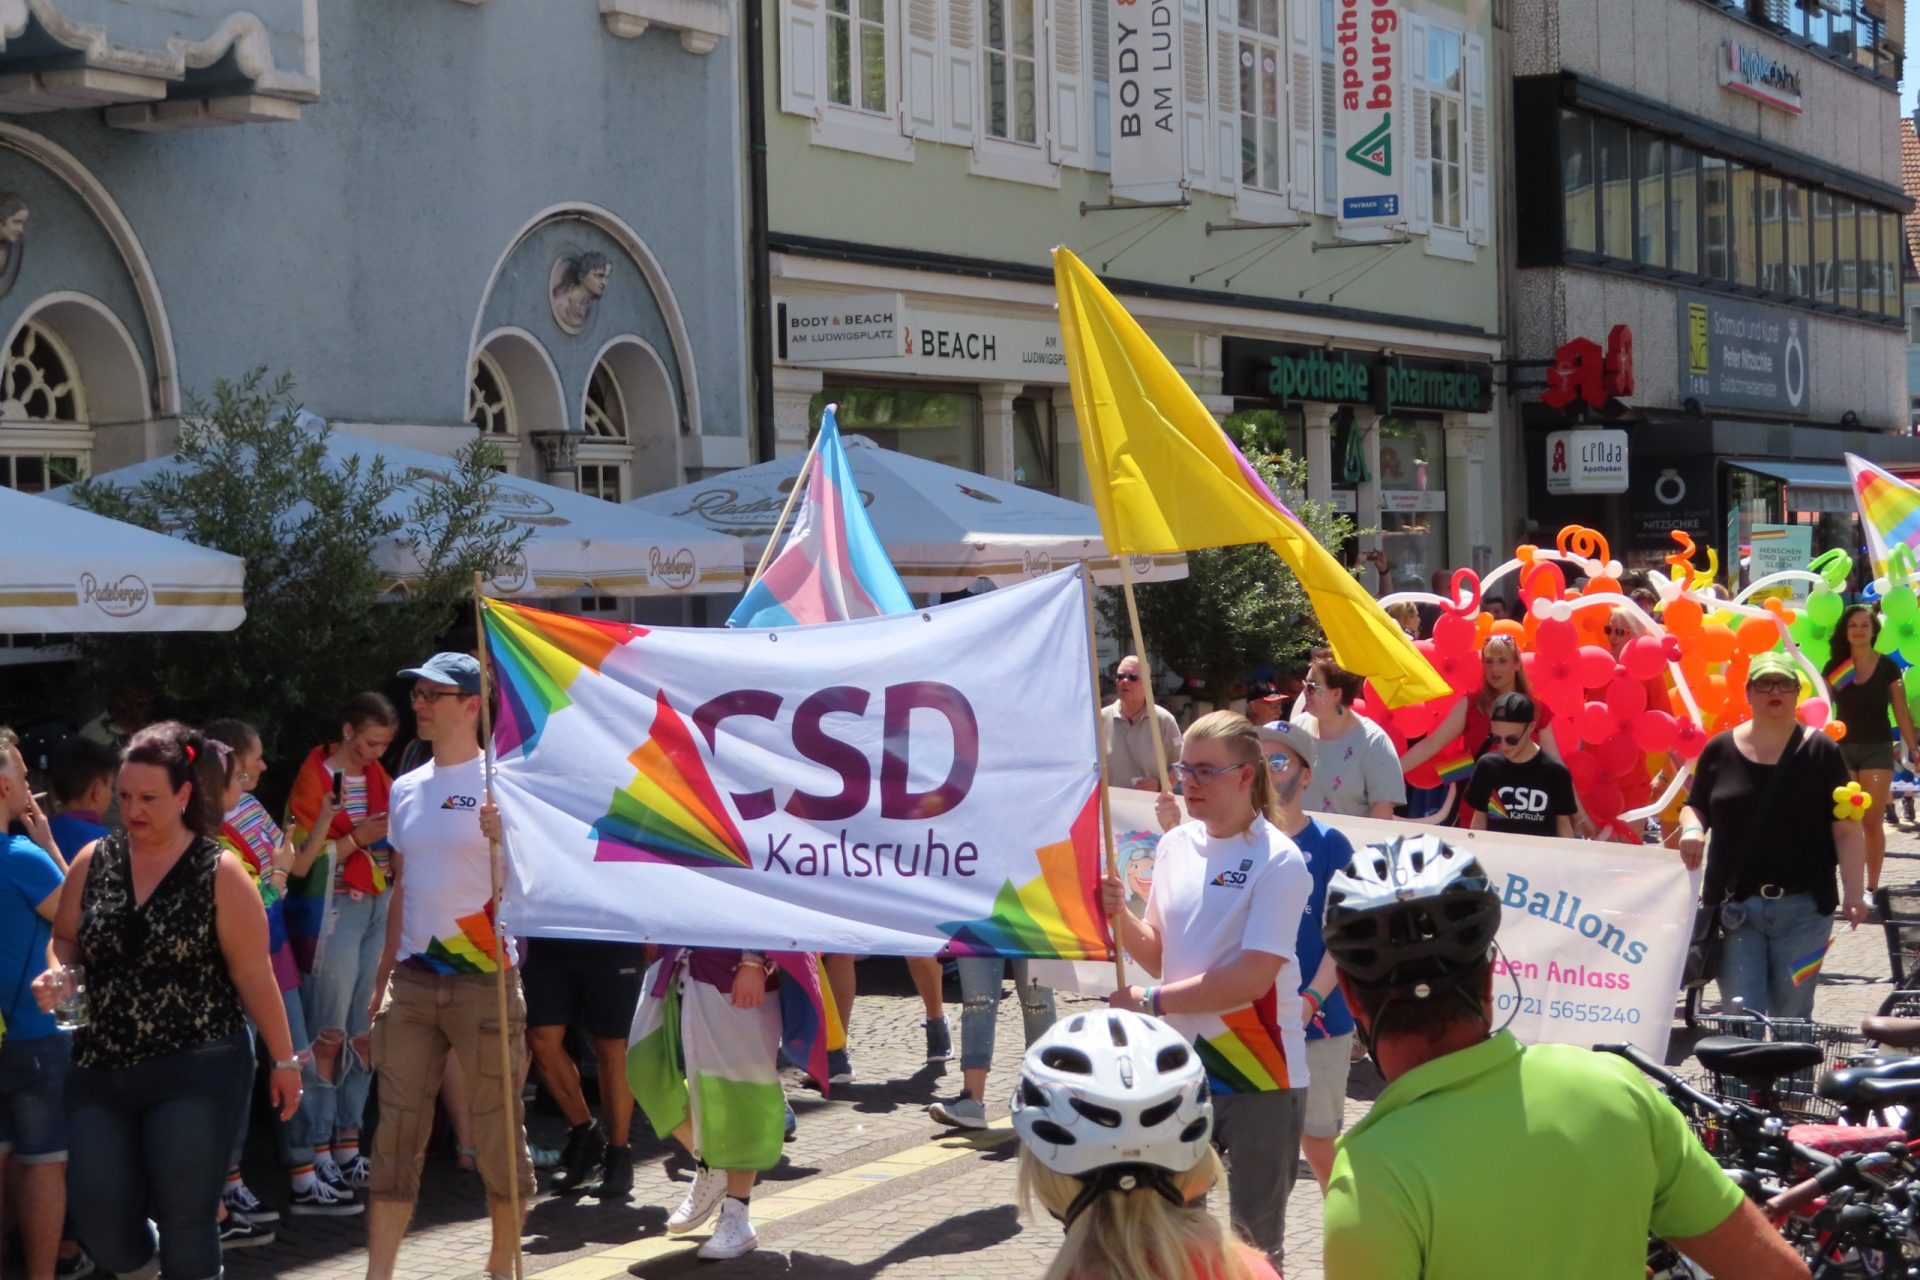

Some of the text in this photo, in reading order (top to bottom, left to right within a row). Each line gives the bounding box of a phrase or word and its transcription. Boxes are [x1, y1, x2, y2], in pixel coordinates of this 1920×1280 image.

[1152, 0, 1173, 133] AM LUD
[1118, 22, 1141, 138] BODY
[1349, 201, 1377, 209] PAYBACK
[791, 313, 893, 328] BODY & BEACH
[792, 330, 893, 343] AM LUDWIGSPLATZ
[921, 330, 996, 361] BEACH
[1045, 336, 1057, 347] AM
[1022, 352, 1067, 365] LUDWIGSPL
[1268, 349, 1480, 414] apotheke pharmacie
[1583, 465, 1622, 474] Apotheken
[1643, 519, 1700, 529] NITZSCHKE
[1759, 547, 1801, 555] MENSCHEN
[81, 572, 147, 609] Radeberger
[692, 681, 979, 821] CSD
[453, 795, 477, 807] CSD
[1498, 786, 1548, 812] CSD
[763, 828, 979, 877] Karlsruhe
[1224, 871, 1247, 884] CSD
[1494, 873, 1648, 965] -Ballons
[1547, 961, 1630, 990] Anlass
[1497, 994, 1640, 1024] 0721 5655240
